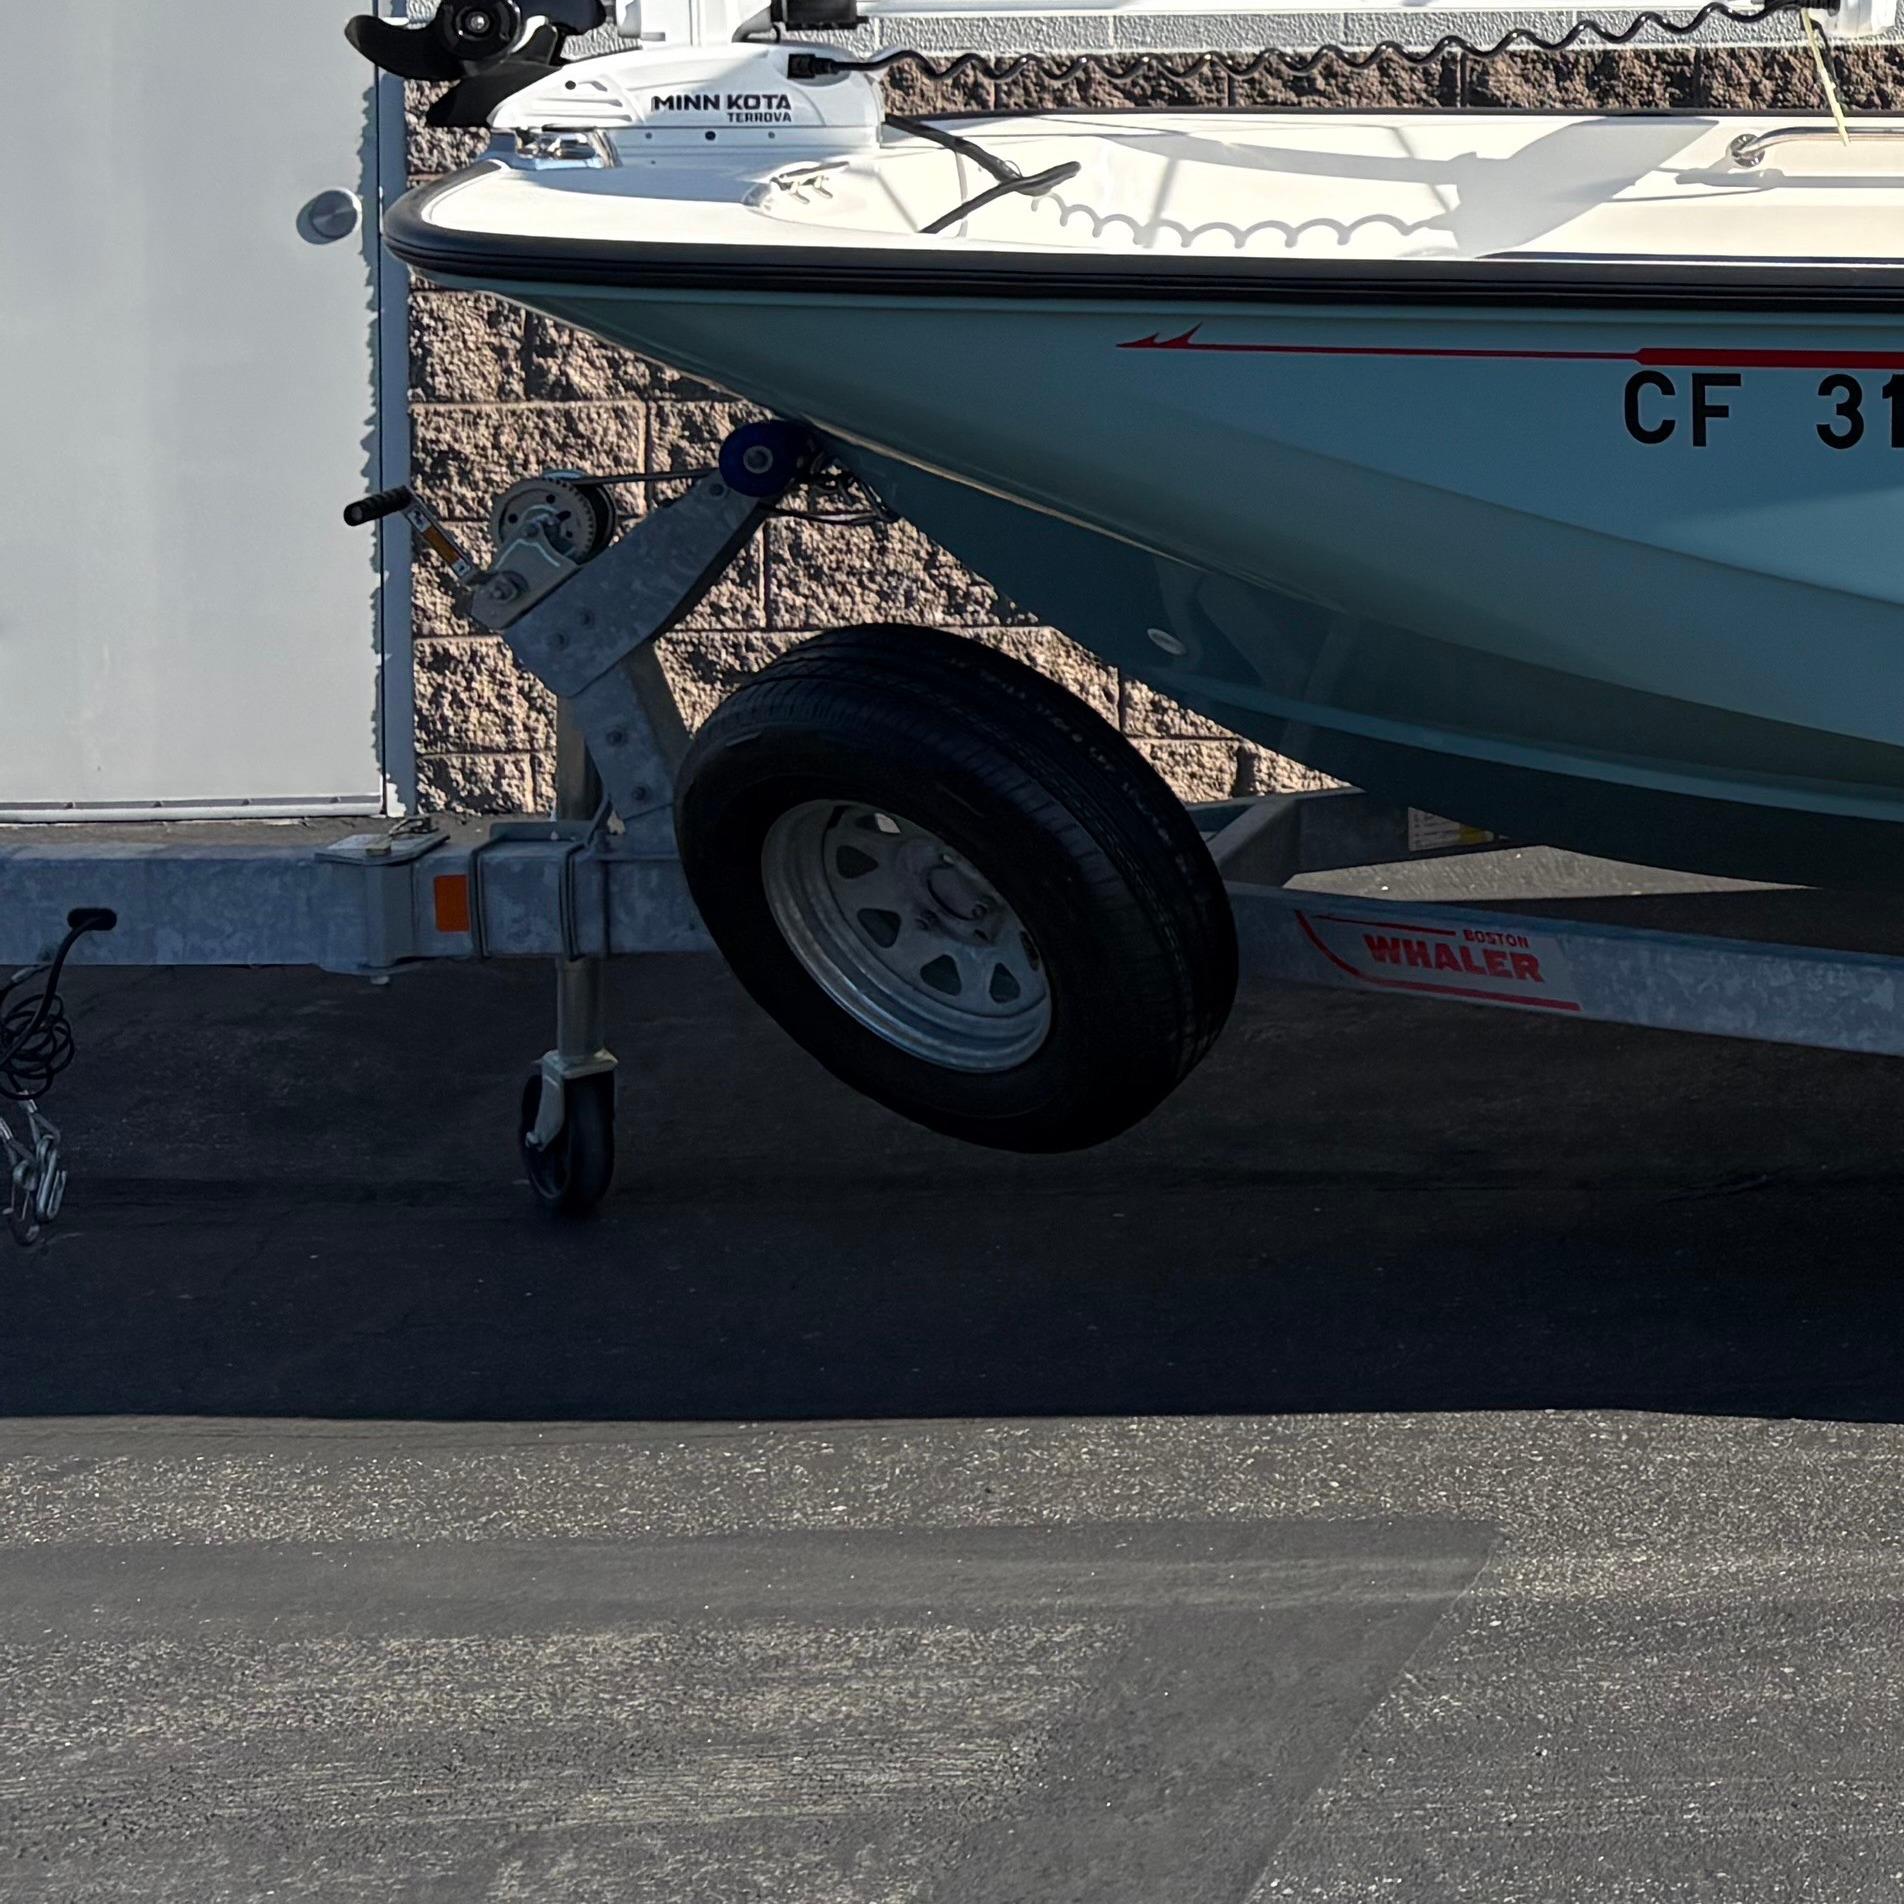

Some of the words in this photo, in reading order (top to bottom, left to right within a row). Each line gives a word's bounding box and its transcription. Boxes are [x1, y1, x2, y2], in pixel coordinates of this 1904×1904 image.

[653, 94, 720, 110] MINN
[726, 94, 792, 110] KOTA
[727, 112, 792, 124] TERROVA
[1623, 369, 1743, 448] CF
[1463, 928, 1530, 948] BOSTON
[1364, 934, 1545, 982] WHALER
